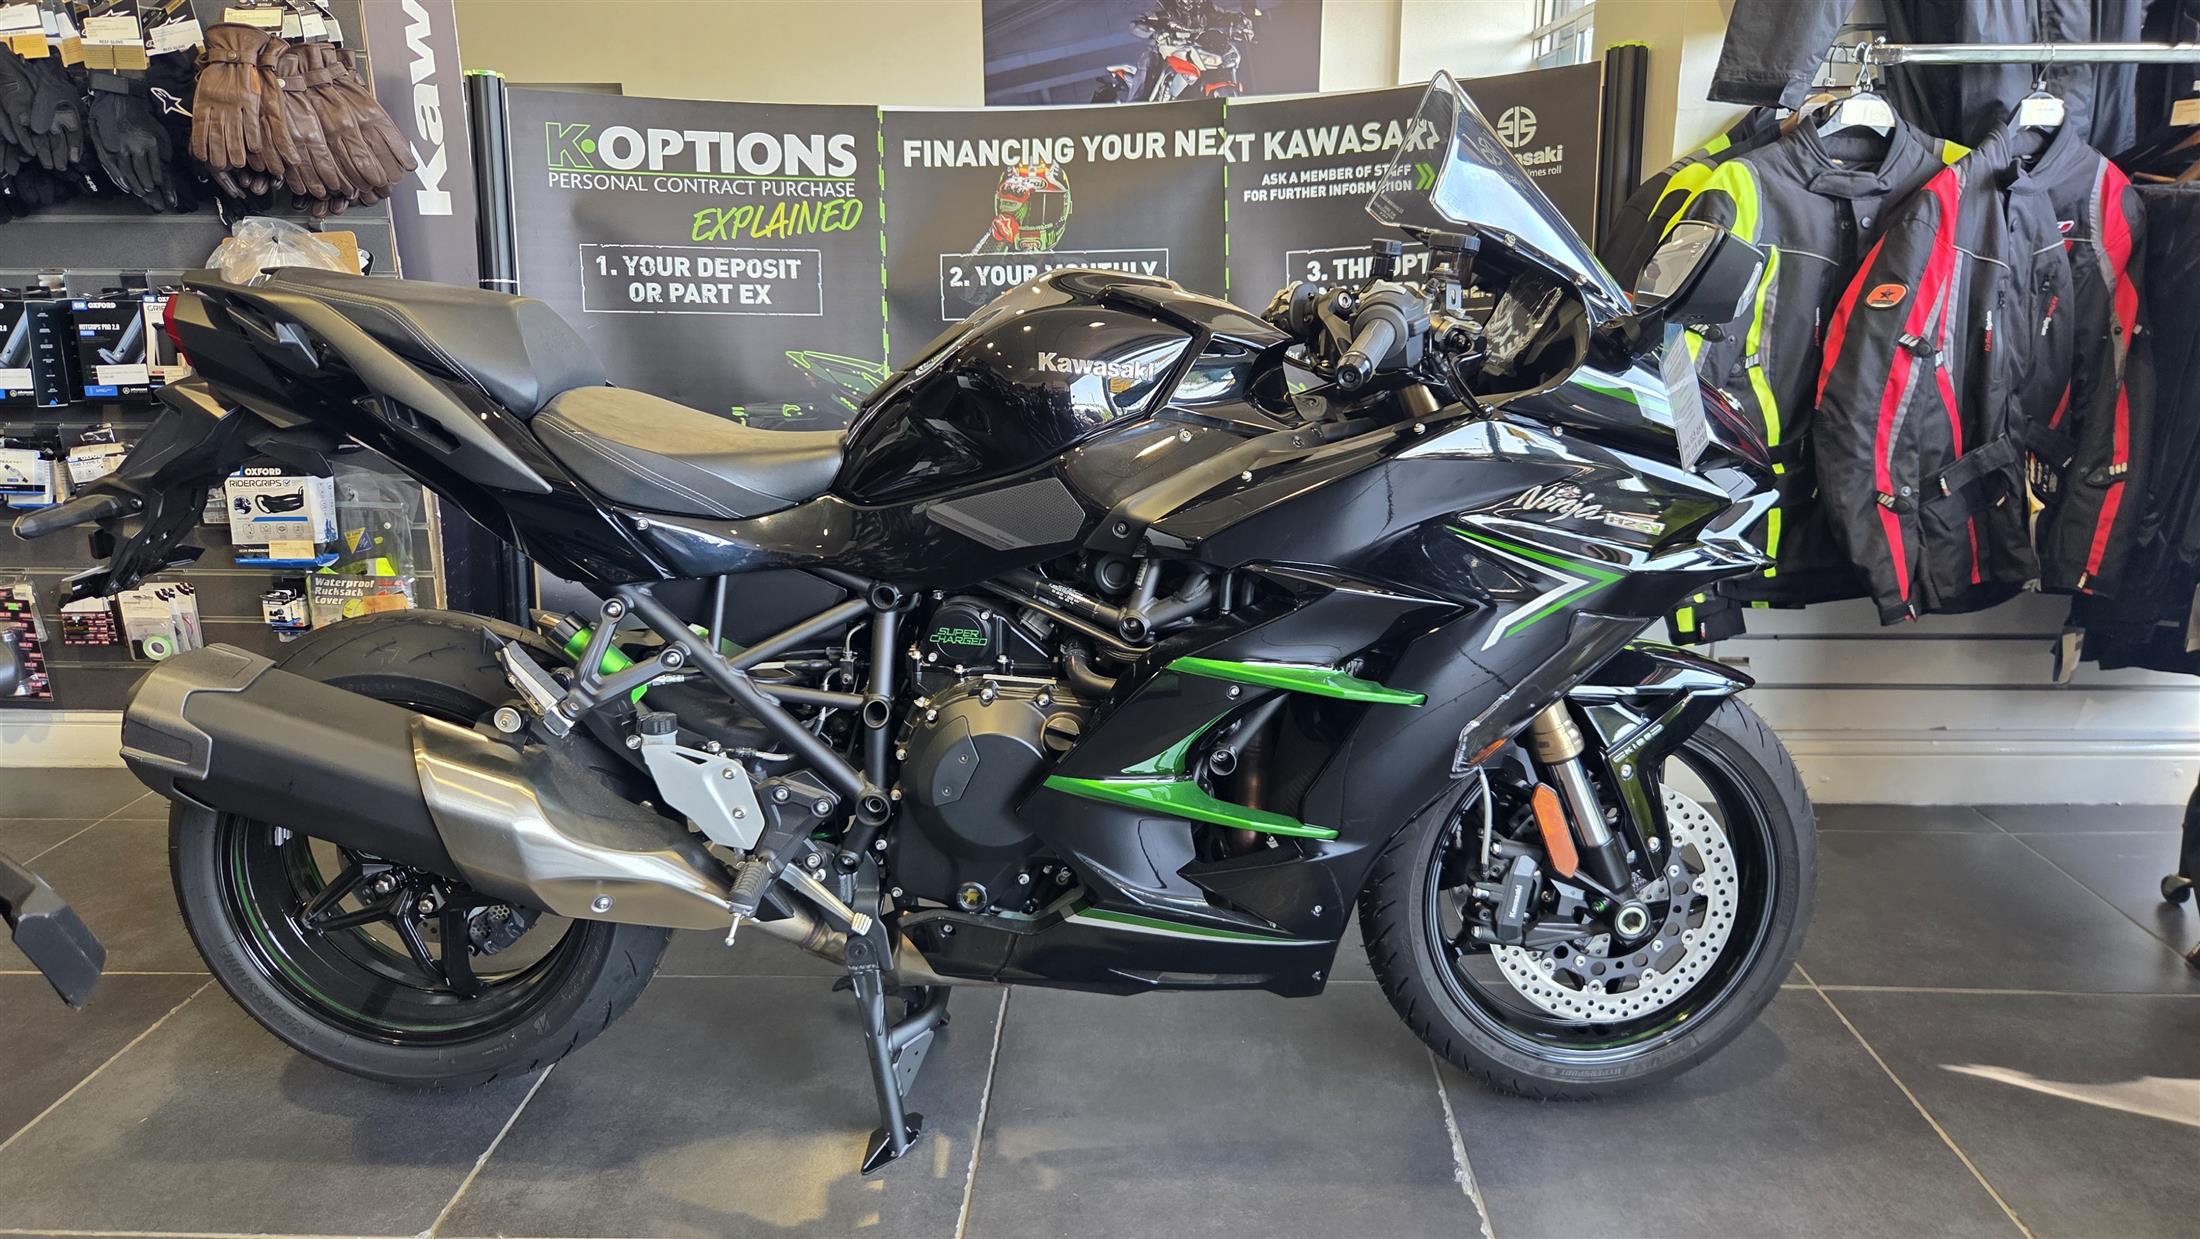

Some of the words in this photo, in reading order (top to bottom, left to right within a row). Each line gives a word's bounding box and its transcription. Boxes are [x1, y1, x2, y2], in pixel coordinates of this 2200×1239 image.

[903, 136, 1075, 168] FINANCING
[1081, 132, 1168, 163] YOUR
[1174, 127, 1255, 163] NEXT
[1262, 173, 1286, 187] ASK
[1288, 172, 1298, 185] A
[1300, 168, 1353, 184] MEMBER
[1355, 166, 1372, 180] OF
[1548, 164, 1562, 176] roll
[549, 172, 648, 191] PERSONAL
[654, 176, 755, 196] CONTRACT
[762, 181, 856, 198] PURCHASE
[1244, 189, 1268, 203] FOR
[1270, 185, 1326, 202] FURTHER
[691, 198, 863, 242] EXPLAINED
[596, 255, 617, 277] 1.
[622, 255, 691, 278] YOUR
[698, 257, 801, 280] DEPOSIT
[949, 266, 970, 287] 2.
[975, 265, 1037, 287] YOUR
[1307, 261, 1328, 282] 3.
[629, 282, 663, 304] OR
[669, 282, 733, 304] PART
[740, 284, 773, 305] EX
[1038, 352, 1156, 382] Kawasaki
[245, 467, 282, 476] OXFORD
[229, 479, 282, 488] RIDERGRIPS
[1513, 485, 1604, 523] Ninja
[315, 578, 375, 588] Waterproof
[315, 587, 364, 597] Rucksack
[315, 596, 344, 605] Cover
[929, 635, 988, 646] CHARGED
[937, 627, 979, 637] SUPER
